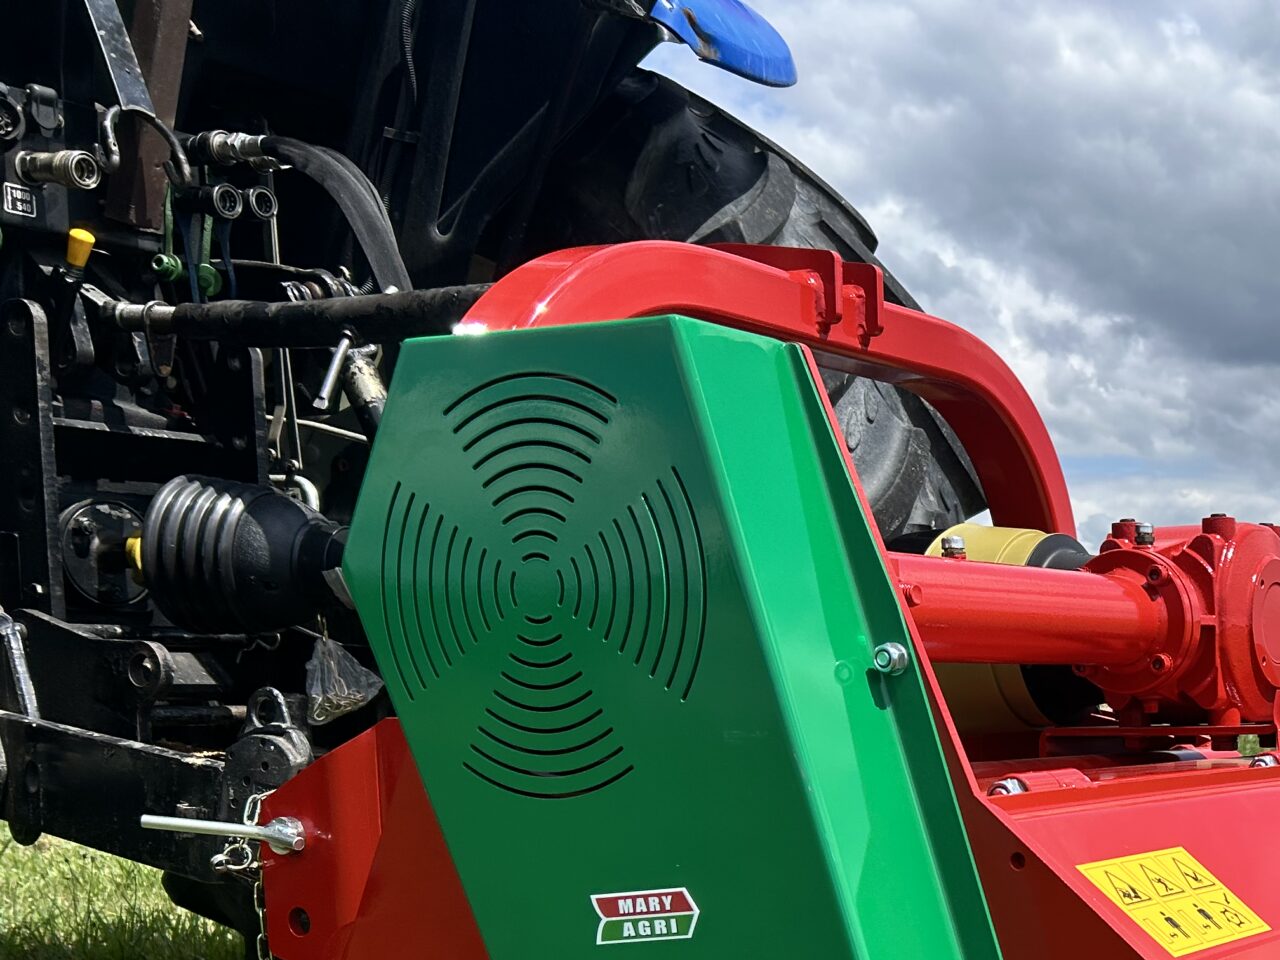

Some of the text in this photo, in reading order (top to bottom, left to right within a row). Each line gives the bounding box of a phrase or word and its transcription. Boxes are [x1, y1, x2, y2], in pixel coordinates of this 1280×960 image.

[11, 189, 31, 201] 1000
[16, 201, 32, 213] 540
[617, 894, 673, 915] MARY
[622, 918, 678, 938] AGRI
